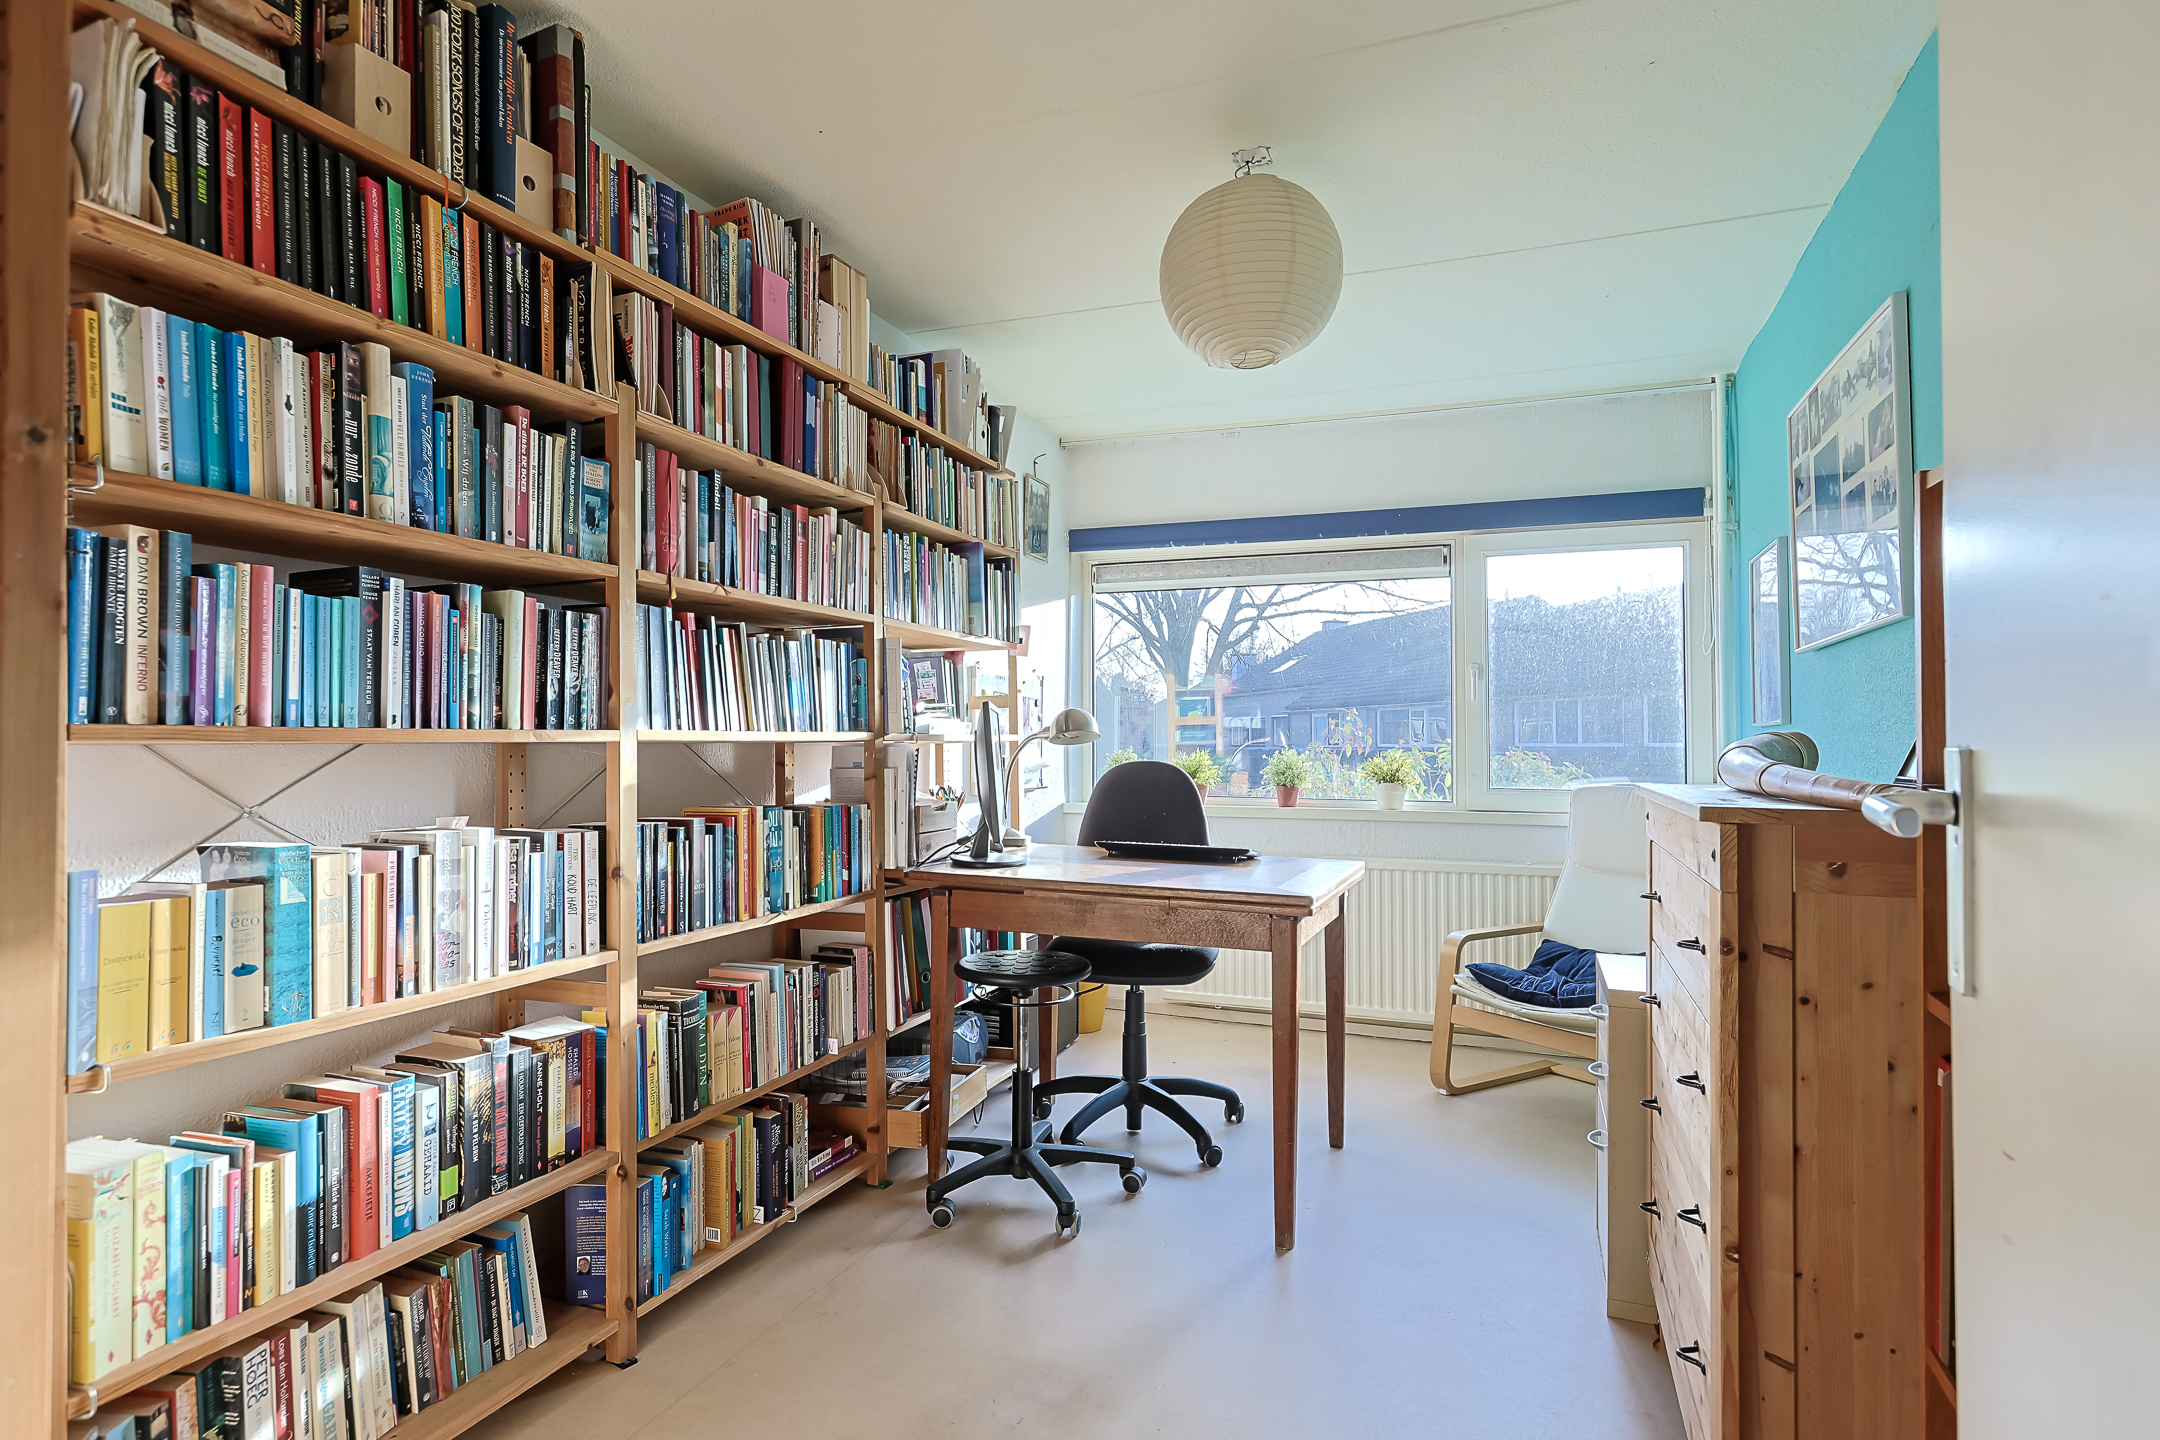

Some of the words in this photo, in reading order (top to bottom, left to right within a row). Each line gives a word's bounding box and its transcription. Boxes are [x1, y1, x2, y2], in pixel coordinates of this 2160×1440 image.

[450, 3, 462, 25] 100
[474, 29, 480, 37] of
[507, 20, 515, 37] De
[451, 23, 463, 62] FOLK
[503, 39, 515, 102] natuurlijke
[452, 62, 463, 112] SONGS
[163, 101, 176, 124] nicci
[452, 113, 463, 135] OF
[506, 103, 515, 145] keuken
[164, 124, 178, 153] french
[196, 117, 208, 139] nicci
[197, 139, 209, 166] french
[453, 133, 464, 186] TODAY
[197, 166, 207, 178] DE
[198, 179, 207, 204] GUNST
[262, 174, 270, 217] FRENCH
[714, 207, 732, 217] FRANK
[733, 202, 745, 210] RICH
[395, 235, 404, 274] FRENCH
[181, 330, 189, 354] Isabel
[182, 354, 190, 383] Allende
[521, 417, 527, 429] De
[521, 456, 527, 469] DE
[418, 466, 434, 501] Engelen
[116, 548, 127, 592] WOESTE
[137, 556, 149, 585] DAN
[107, 576, 116, 614] BRONTË
[115, 593, 125, 645] HOOGTEN
[137, 588, 148, 639] BROWN
[262, 623, 268, 632] in
[137, 644, 148, 692] INFERNO
[571, 651, 580, 676] DEAVER
[233, 856, 242, 864] eco
[509, 842, 519, 862] lisa
[509, 863, 518, 904] gardner
[545, 878, 551, 888] De
[567, 874, 577, 894] KOUD
[587, 878, 597, 888] DE
[230, 908, 261, 917] umberto
[567, 897, 577, 916] HART
[587, 890, 597, 925] LEERLING
[230, 917, 260, 929] eco
[437, 931, 451, 941] De
[393, 1085, 406, 1148] HAILEY
[423, 1139, 432, 1196] GEHAAID
[393, 1148, 414, 1218] NIEUWS
[307, 1206, 316, 1228] Anne
[308, 1229, 314, 1238] en
[307, 1239, 315, 1270] Isabelle
[278, 1336, 287, 1359] Loes
[318, 1335, 325, 1346] De
[328, 1330, 336, 1350] John
[257, 1348, 269, 1400] PETER
[329, 1351, 338, 1377] Irving
[246, 1354, 258, 1409] HØEG
[319, 1375, 328, 1404] volgens
[279, 1382, 288, 1429] Hollander
